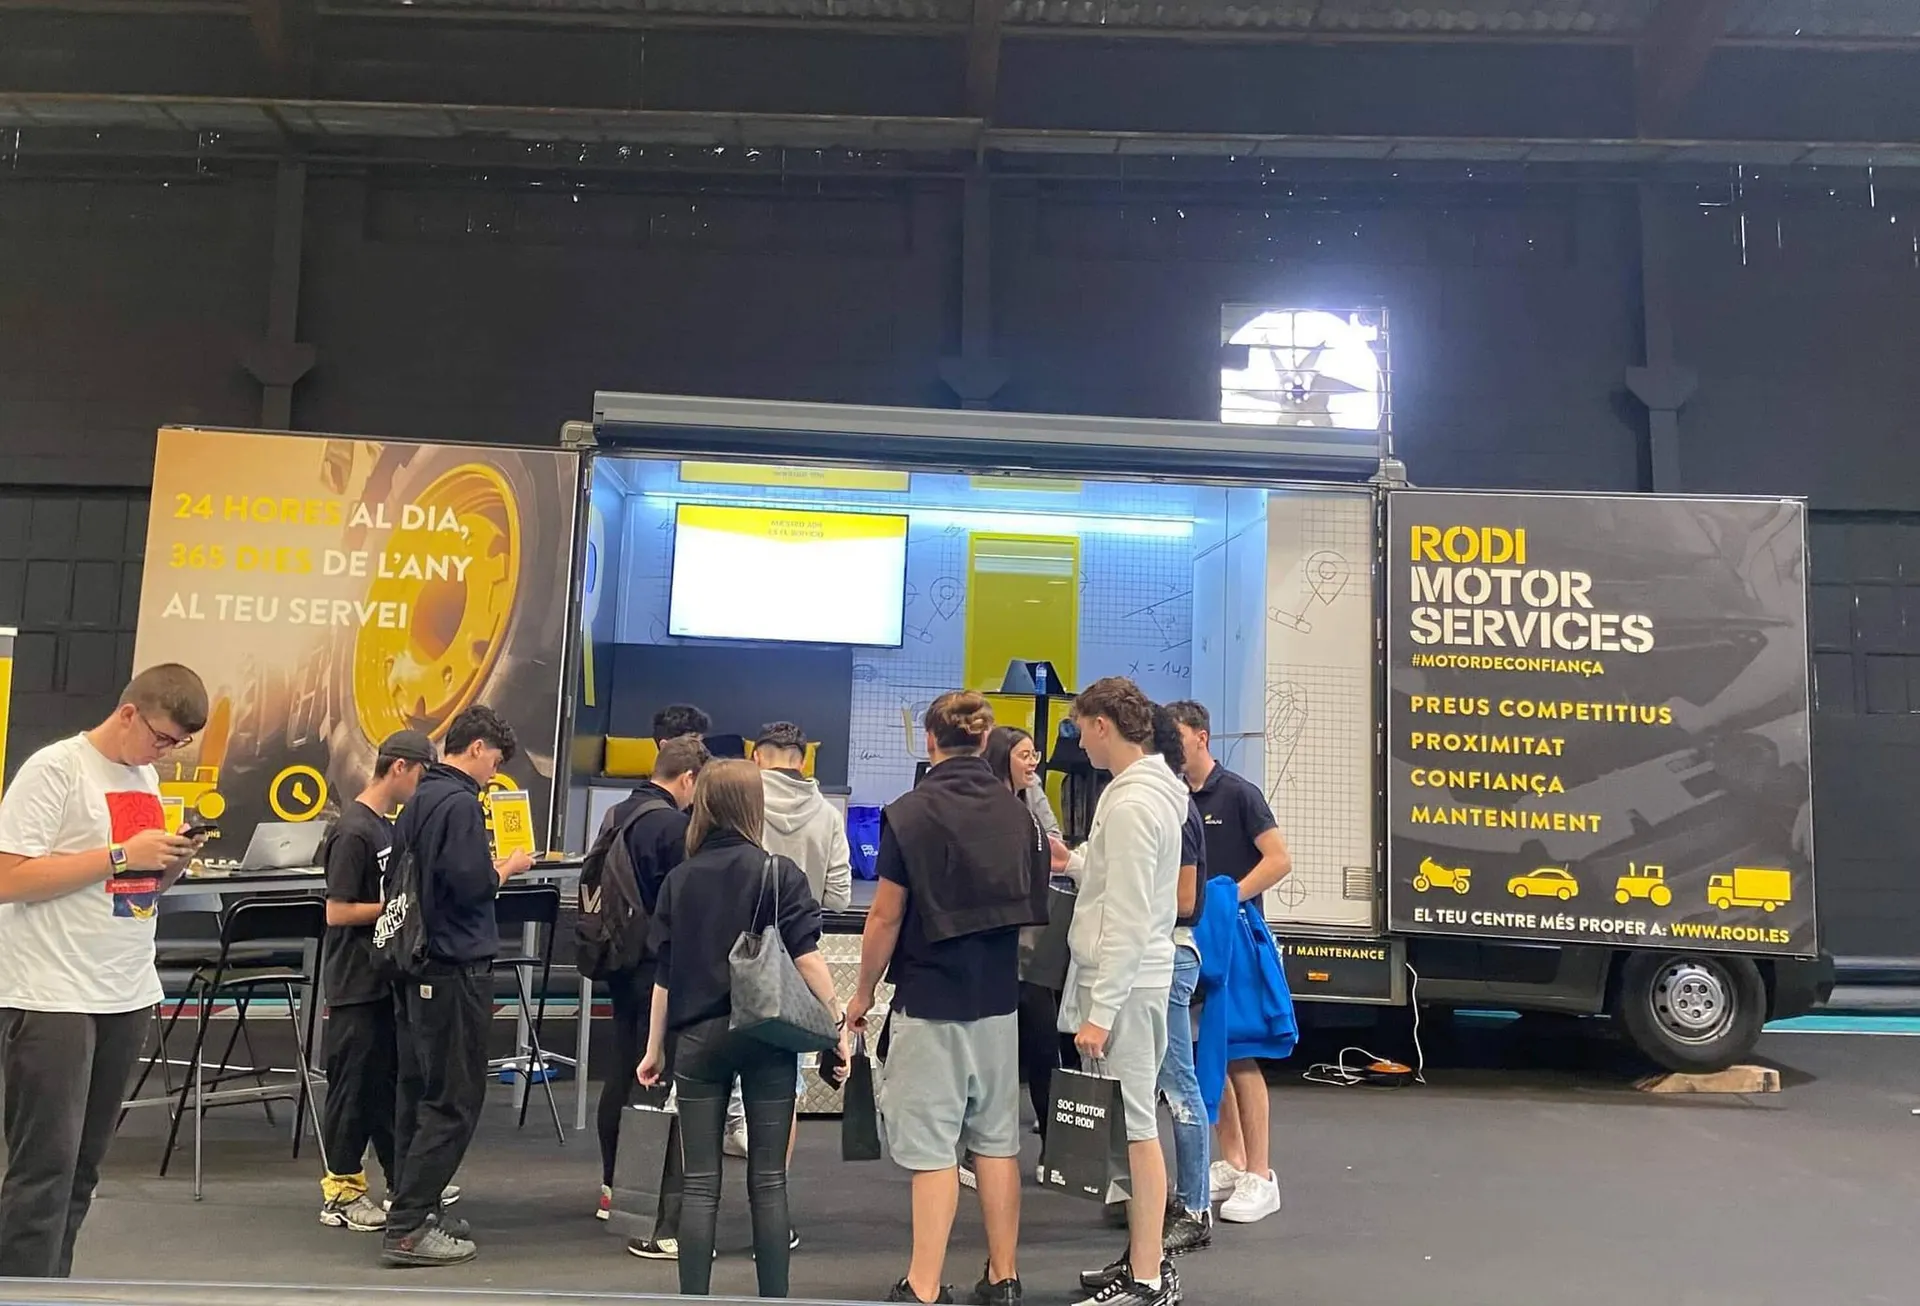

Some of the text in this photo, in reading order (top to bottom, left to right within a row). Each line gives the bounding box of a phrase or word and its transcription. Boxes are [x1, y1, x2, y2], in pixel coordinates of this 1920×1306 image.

[173, 492, 470, 541] 24 HORES AL DIA,
[1410, 525, 1526, 564] RODI
[168, 542, 227, 571] 365
[235, 545, 313, 575] DIES
[322, 551, 368, 578] DE
[1409, 566, 1594, 609] MOTOR
[161, 592, 408, 629] AL TEU SERVEI
[1409, 606, 1655, 654] SERVICES
[1411, 653, 1605, 677] #MOTORDECONFIANÇA
[1410, 695, 1673, 725] PREUS COMPETITIUS
[1410, 732, 1566, 757] PROXIMITAT
[1410, 768, 1566, 797] CONFIANÇA
[1410, 805, 1602, 833] MANTENIMENT
[1414, 908, 1790, 944] EL TEU CENTRE MÉS PROPER A: WWW.RODI.ES
[1296, 944, 1385, 961] MAINTENANCE
[1056, 1112, 1095, 1130] SOC RODI
[1057, 1099, 1105, 1118] SOC MOTOR
